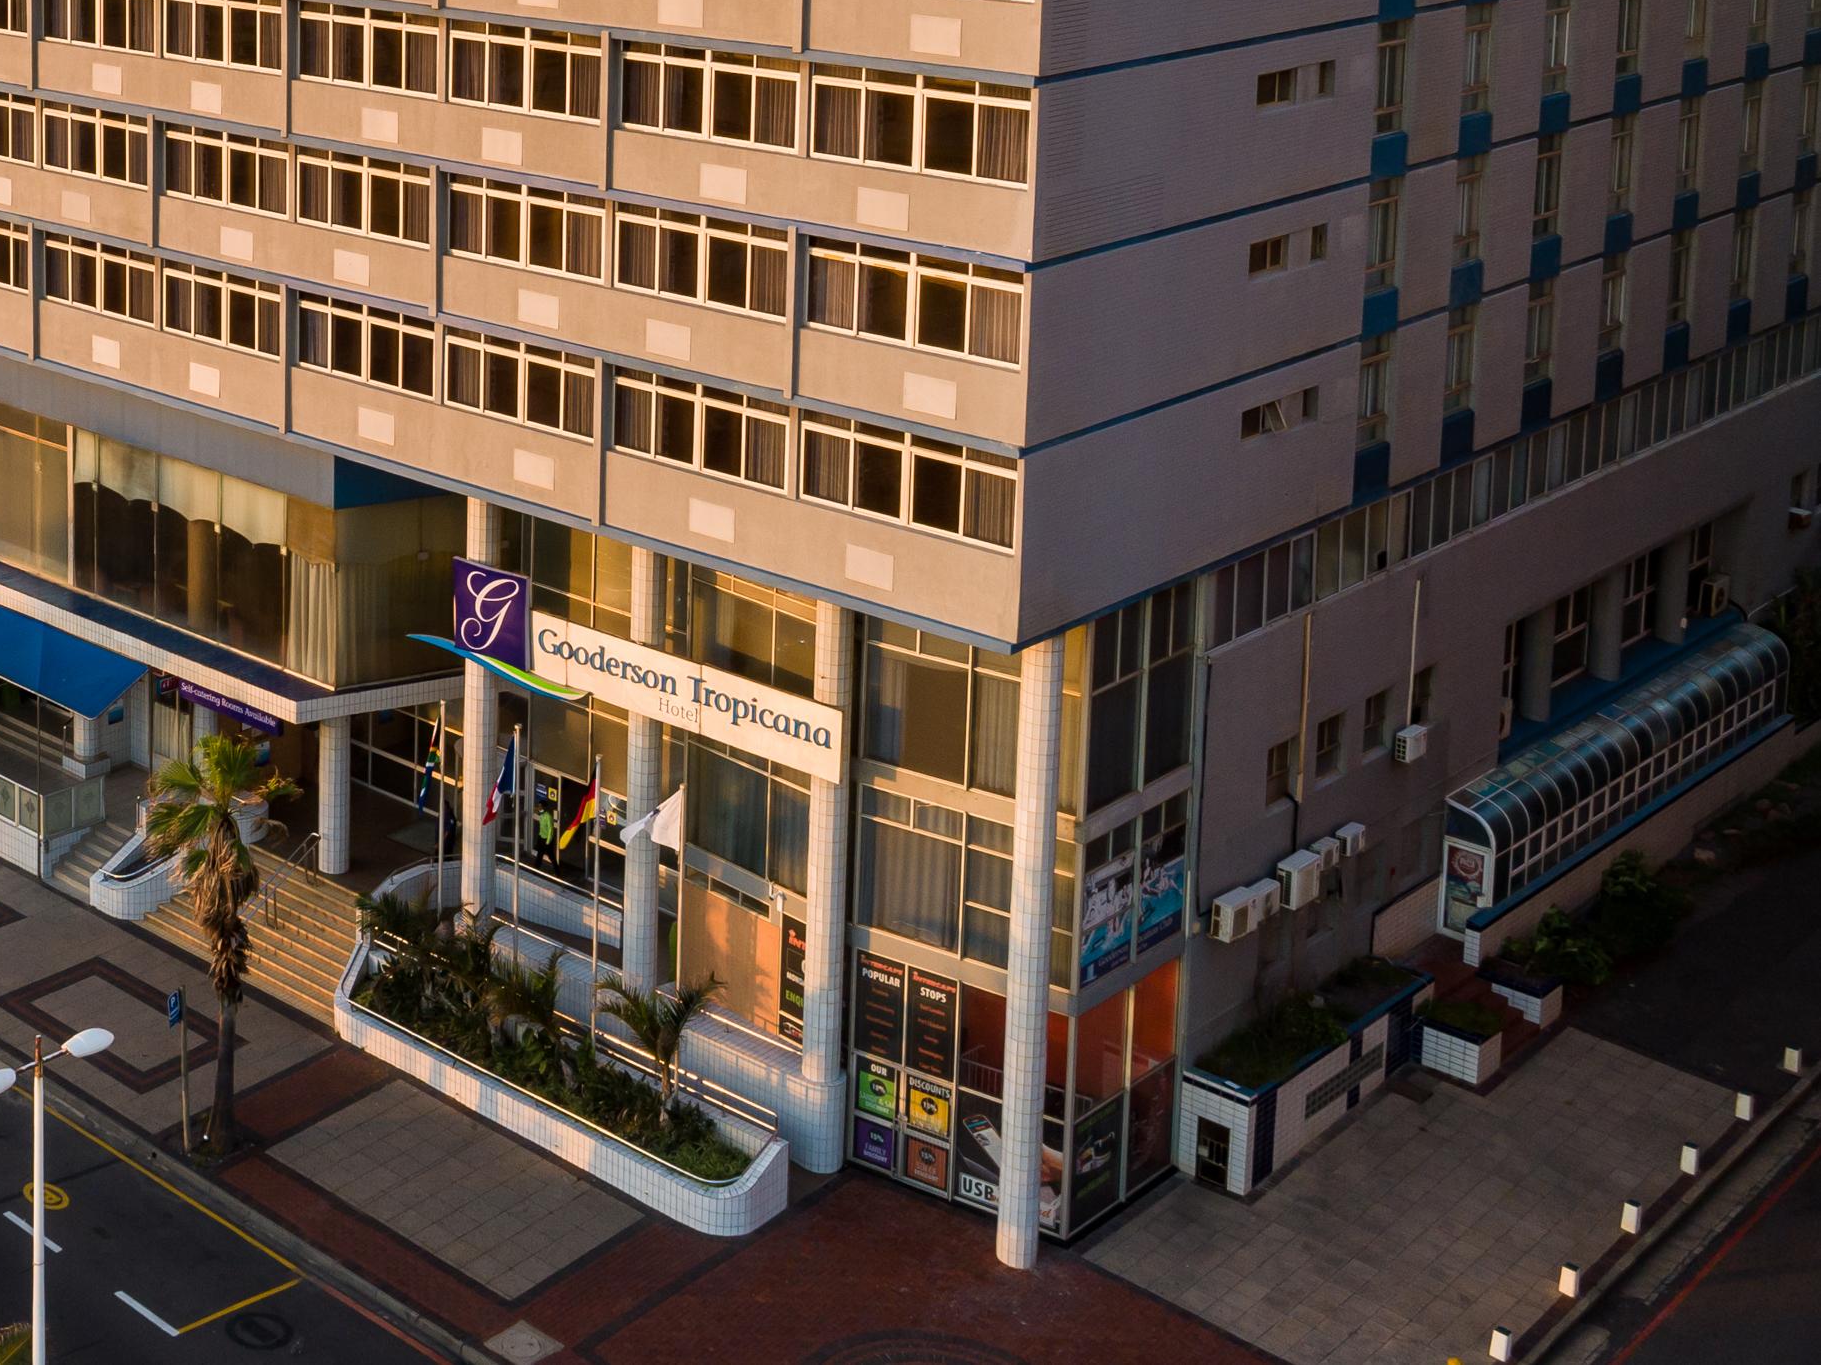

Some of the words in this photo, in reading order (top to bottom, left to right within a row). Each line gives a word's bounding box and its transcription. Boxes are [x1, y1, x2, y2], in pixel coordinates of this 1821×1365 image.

[537, 628, 677, 695] Gooderson
[687, 675, 832, 750] Tropicana
[180, 682, 221, 708] Self-catering
[221, 697, 244, 714] Rooms
[245, 707, 277, 728] Available
[658, 697, 700, 725] Hotel
[862, 967, 901, 988] POPULAR
[920, 986, 947, 1004] STOPS
[870, 1063, 888, 1077] OUR
[909, 1076, 951, 1099] DISCOUNTS
[962, 1176, 995, 1200] USB
